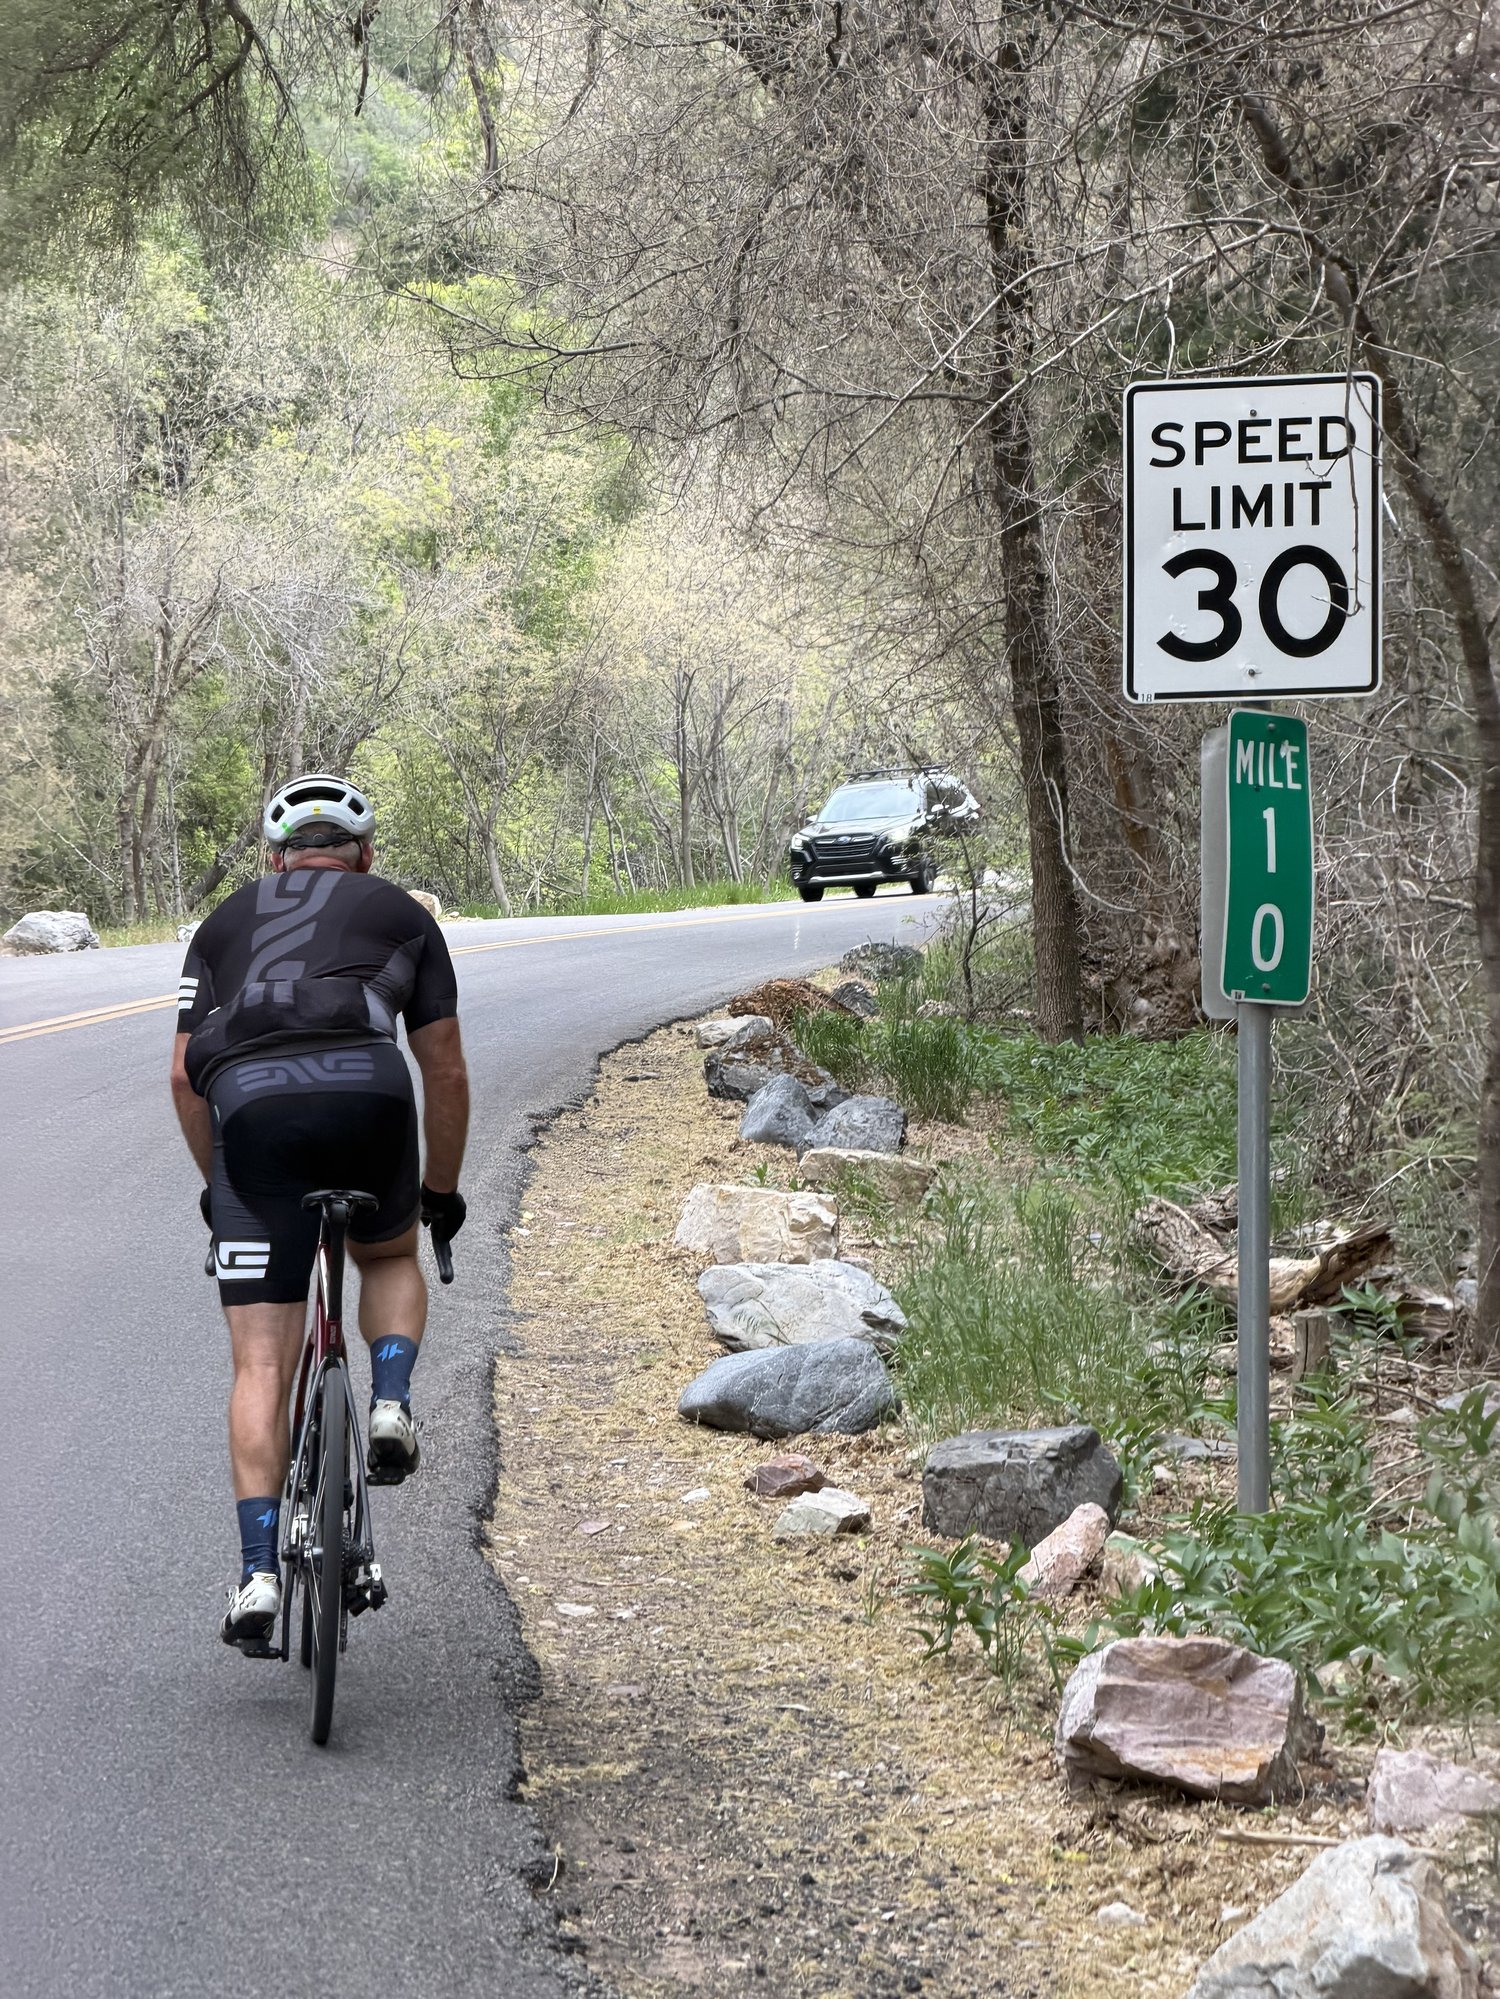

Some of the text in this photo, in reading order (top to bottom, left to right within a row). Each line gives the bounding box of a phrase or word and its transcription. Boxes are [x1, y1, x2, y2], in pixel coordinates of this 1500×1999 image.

[1149, 415, 1356, 468] SPEED
[1172, 481, 1332, 531] LIMIT
[1156, 544, 1350, 662] 30
[1236, 739, 1302, 789] MILE
